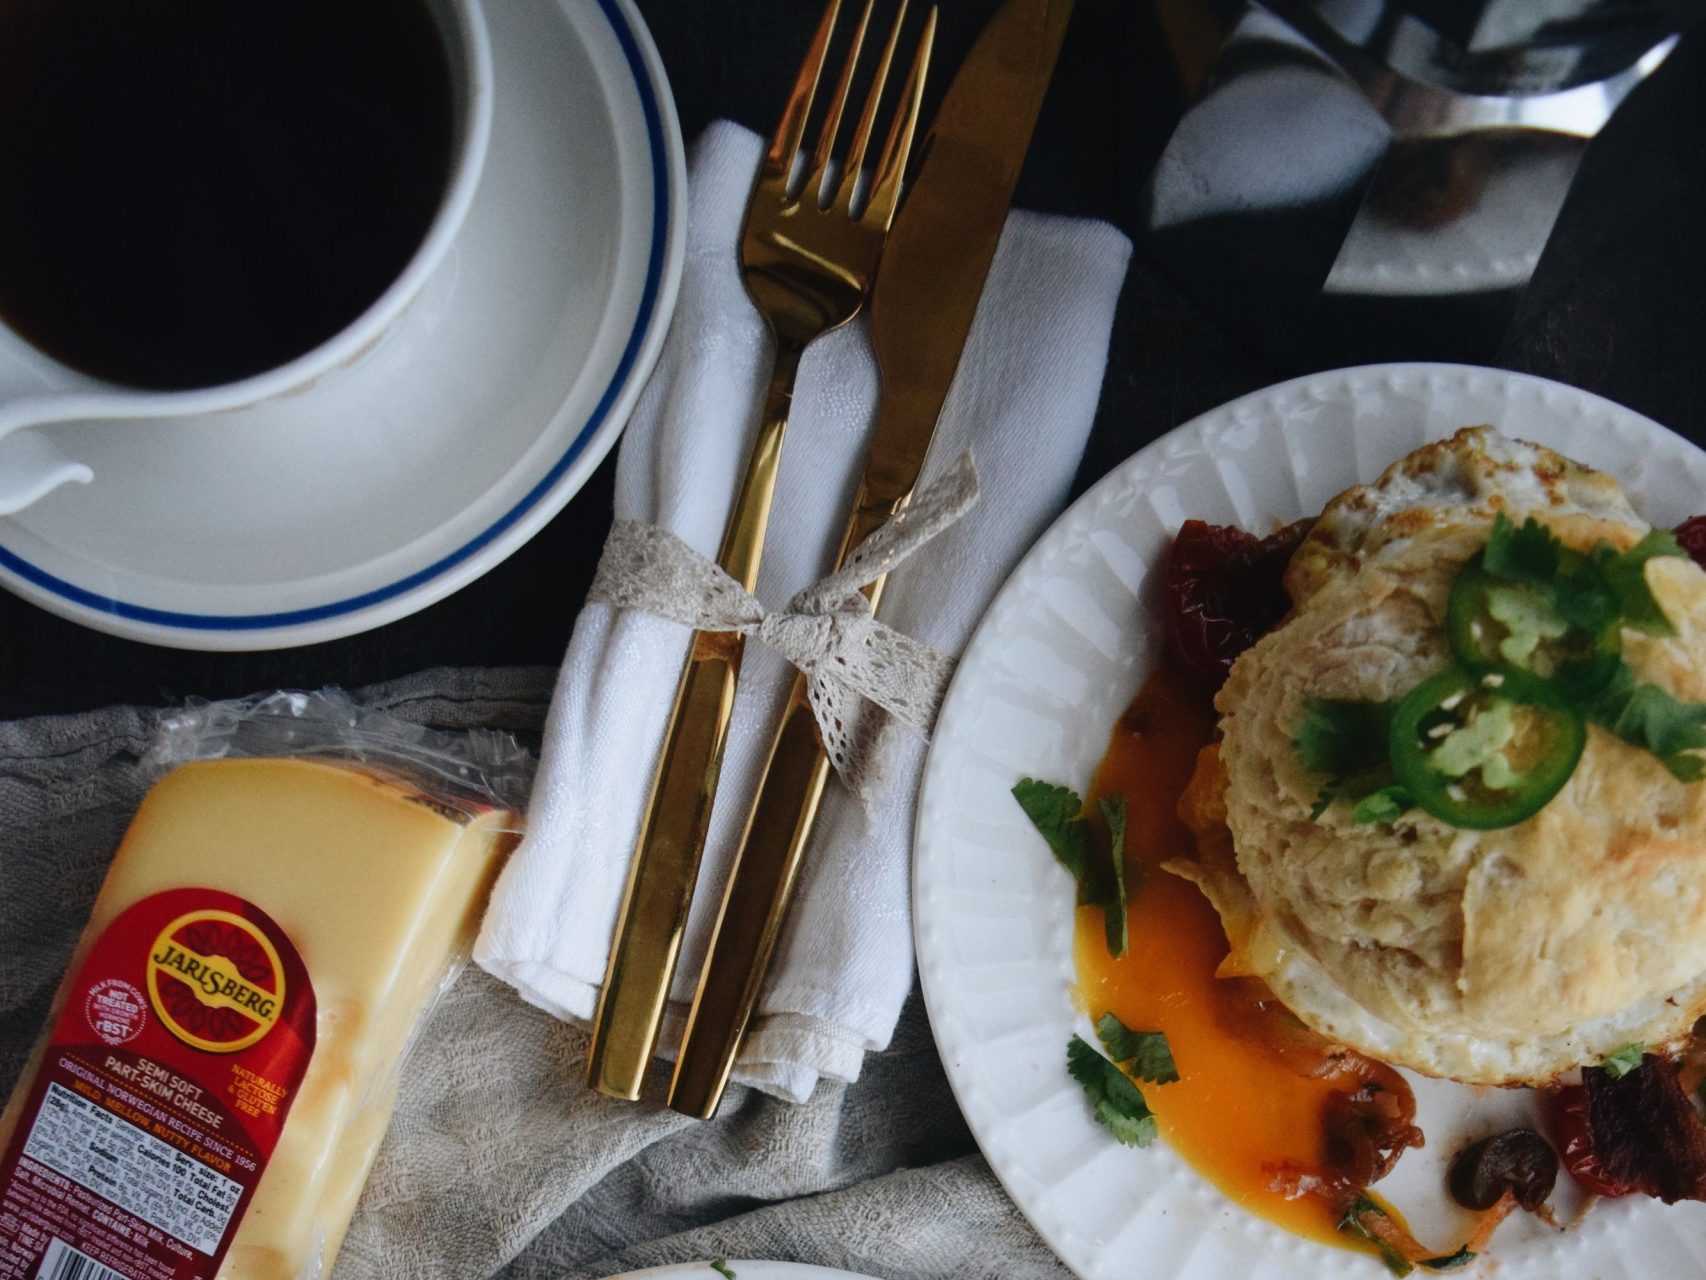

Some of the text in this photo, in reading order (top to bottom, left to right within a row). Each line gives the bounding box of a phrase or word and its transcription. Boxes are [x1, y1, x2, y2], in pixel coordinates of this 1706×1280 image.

[110, 989, 128, 1001] NOT
[153, 946, 275, 1018] JARLSBERG
[97, 994, 138, 1013] TREATED
[105, 1056, 223, 1128] PART-SKIM CHEESE
[137, 1058, 203, 1100] SEMI SOFT
[232, 1064, 287, 1098] NATURALLY
[234, 1076, 279, 1105] LACTOSE
[59, 1058, 257, 1171] ORIGINAL NORWEGIAN RECIPE SINCE 1956
[227, 1084, 277, 1115] & GLUTEN
[236, 1099, 261, 1117] FREE
[51, 1085, 88, 1110] Nutrition
[90, 1106, 114, 1123] Facts
[175, 1153, 198, 1169] Serv.
[199, 1167, 219, 1182] size:
[230, 1185, 241, 1194] oz
[153, 1124, 190, 1149] NUTTY
[191, 1145, 232, 1172] FLAVOR
[88, 1165, 119, 1187] Protein
[89, 1142, 120, 1163] Sodium
[172, 1188, 196, 1205] Total
[195, 1201, 218, 1218] Carb.
[137, 1144, 172, 1168] Calories
[189, 1173, 212, 1190] Total
[212, 1186, 227, 1198] Fat
[18, 1156, 196, 1261] INGREDIENTS: Pasteurized Part-Skim Milk, Culture,
[197, 1190, 233, 1213] Cholest.
[92, 1210, 134, 1238] CONTAINS:
[133, 1232, 150, 1247] Milk
[81, 1241, 100, 1256] KEEP
